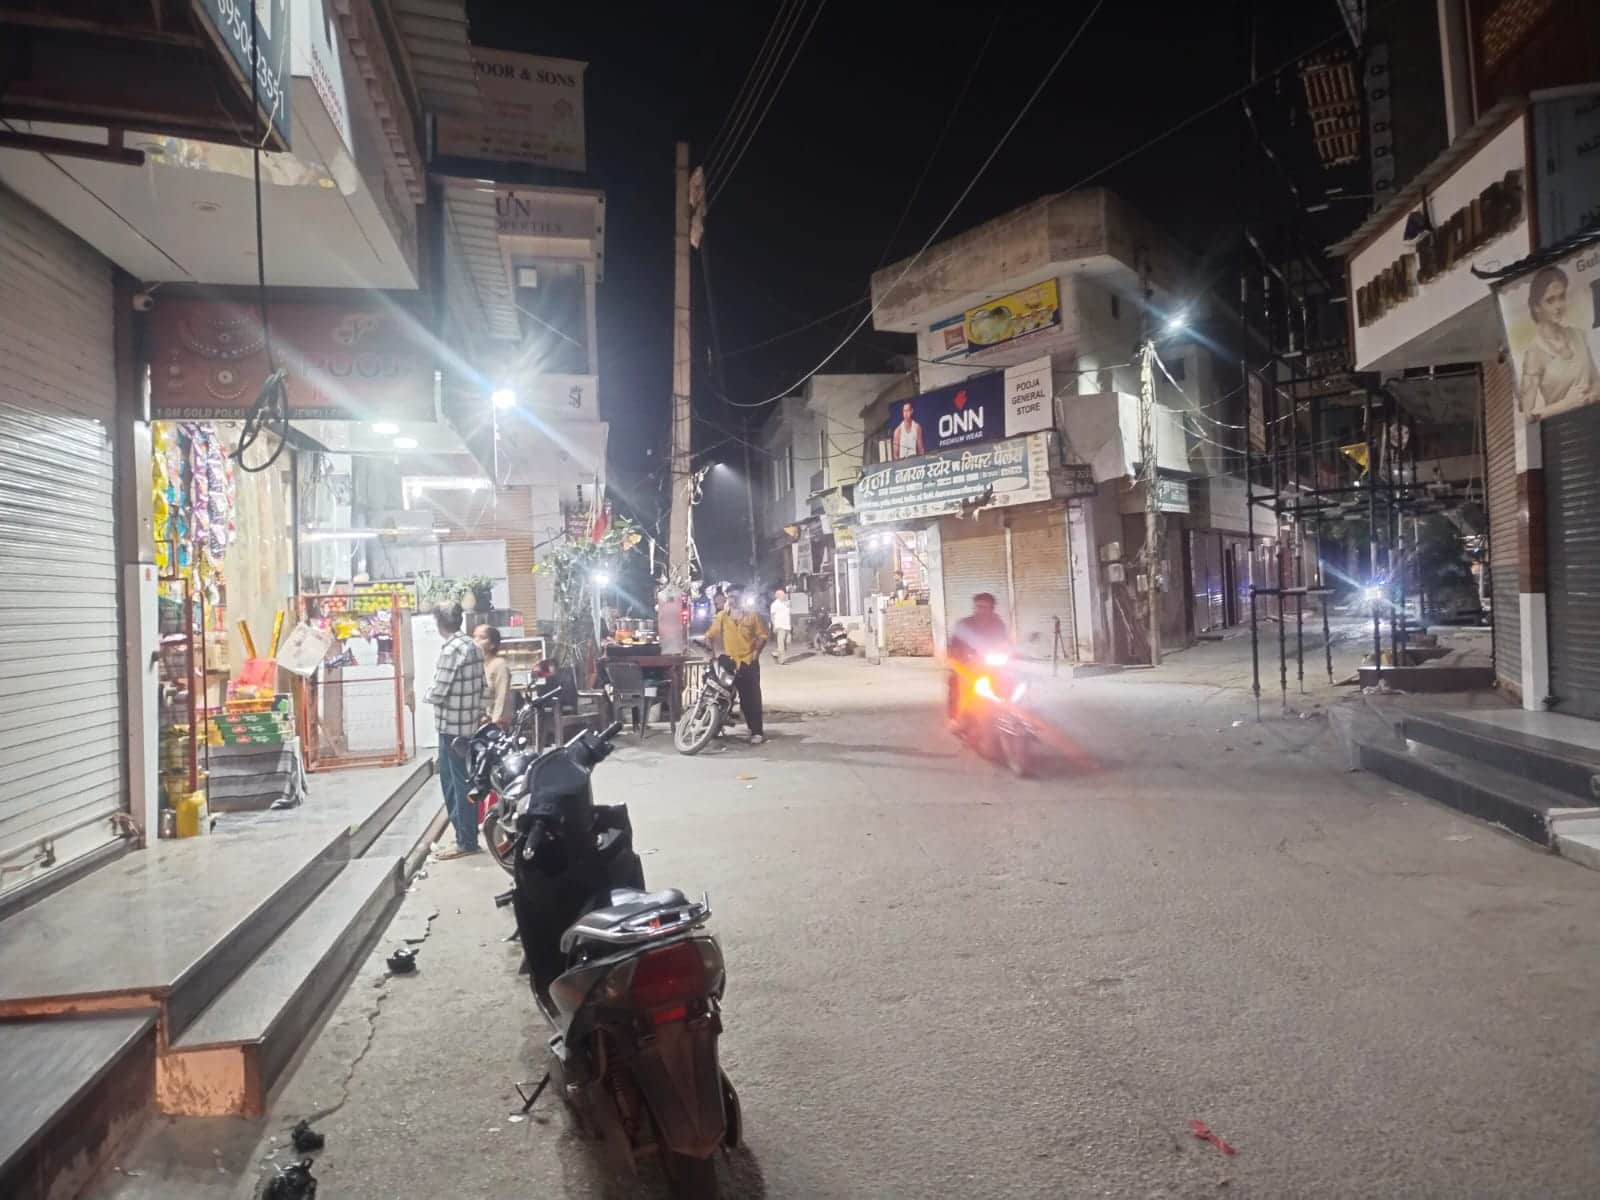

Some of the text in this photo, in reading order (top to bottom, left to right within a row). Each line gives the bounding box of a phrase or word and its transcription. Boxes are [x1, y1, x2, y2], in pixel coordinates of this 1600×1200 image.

[519, 68, 530, 81] &
[536, 70, 577, 88] SONS
[1016, 377, 1040, 392] POOJA
[1011, 389, 1046, 406] GENERAL
[183, 408, 212, 418] GOLD
[1016, 401, 1041, 416] STORE
[938, 405, 985, 438] ONN
